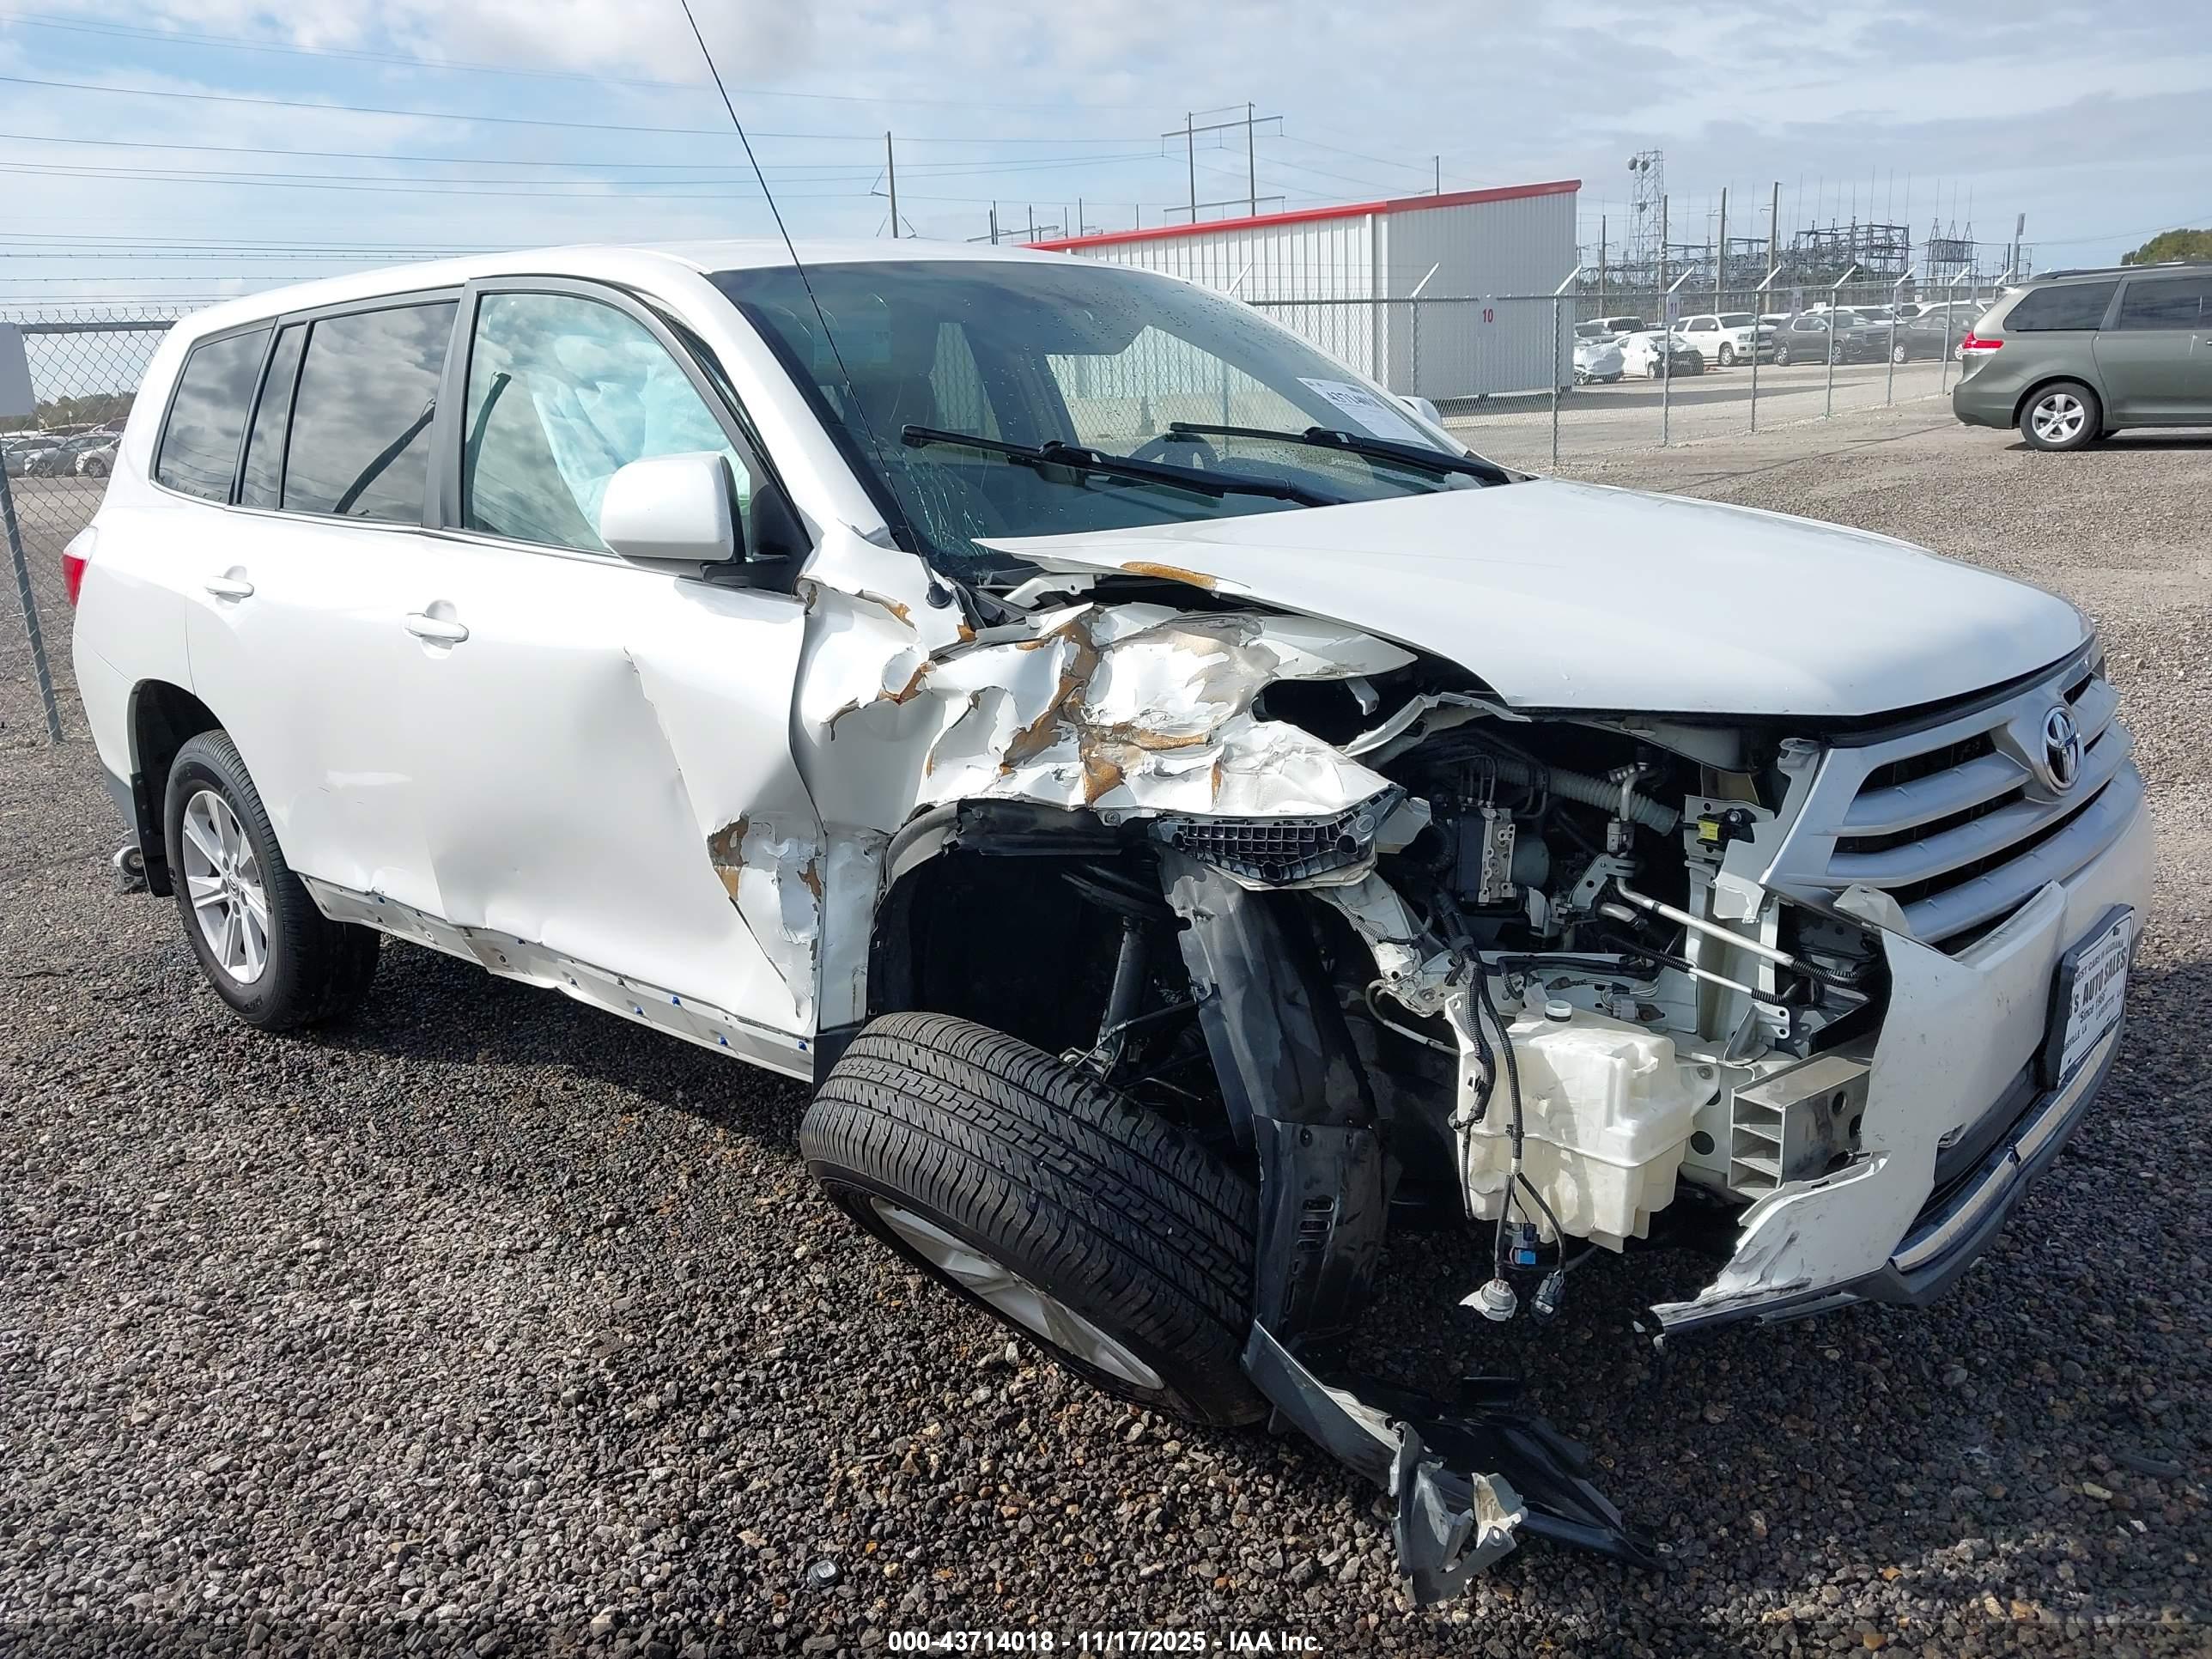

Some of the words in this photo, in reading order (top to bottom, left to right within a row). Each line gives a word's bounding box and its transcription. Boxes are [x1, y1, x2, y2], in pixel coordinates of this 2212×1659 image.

[1482, 308, 1493, 323] 10
[1670, 302, 1677, 314] 11
[2082, 968, 2104, 1006] AUTO
[2104, 946, 2127, 985] SALES
